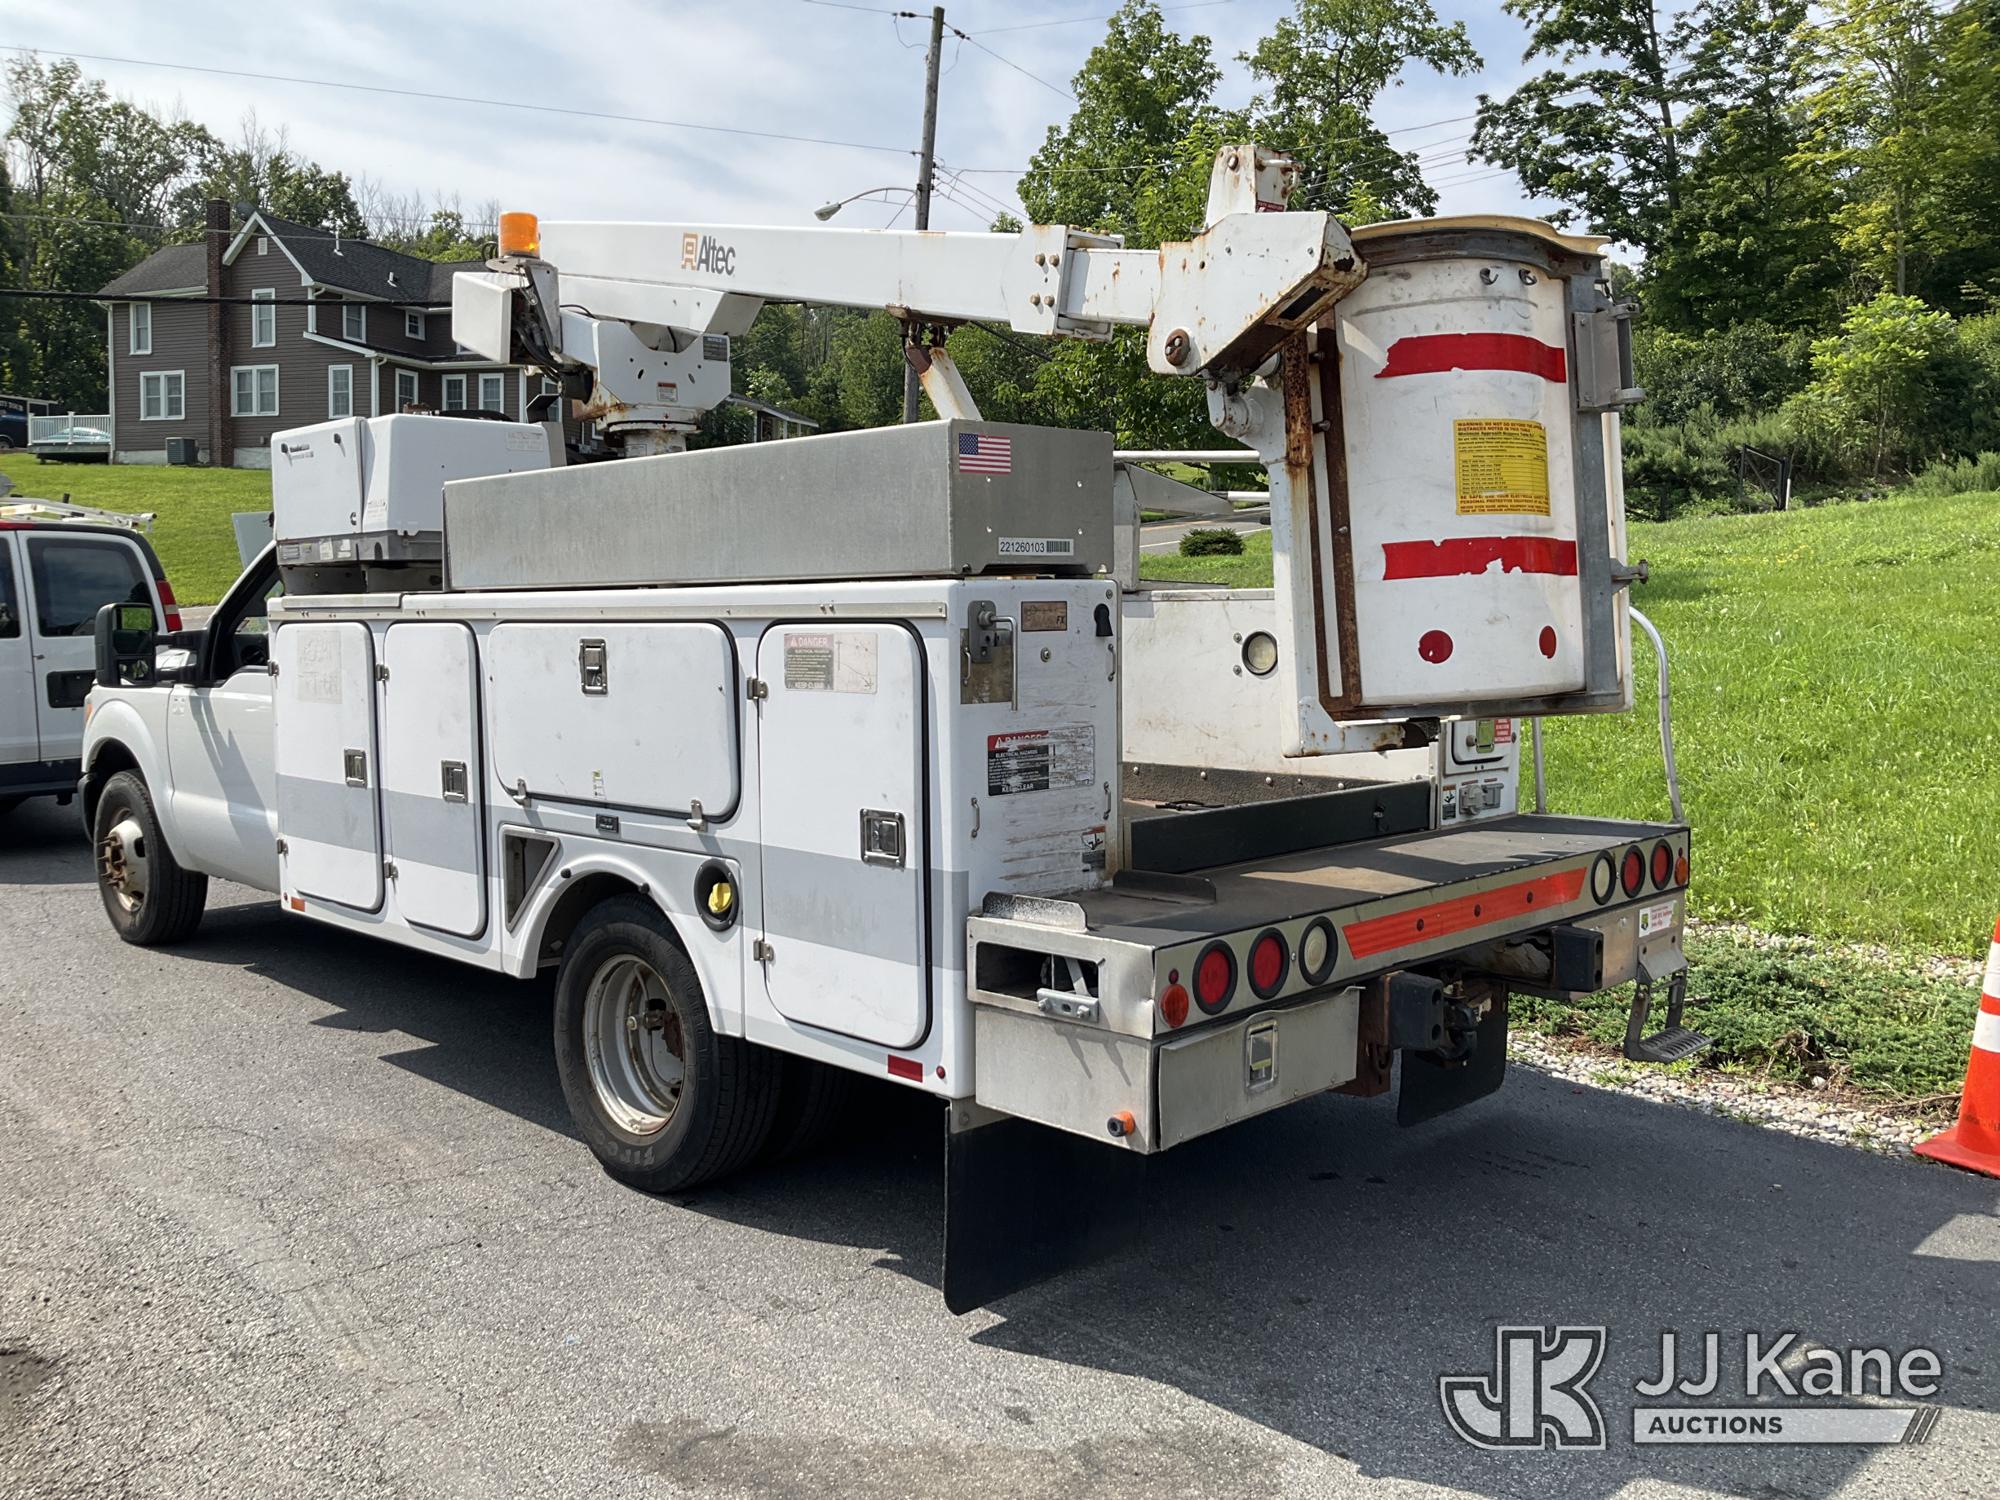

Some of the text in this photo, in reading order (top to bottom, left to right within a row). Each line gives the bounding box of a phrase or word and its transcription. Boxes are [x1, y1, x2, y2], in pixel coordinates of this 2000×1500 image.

[697, 235, 736, 276] Altec
[1000, 541, 1045, 553] 221260103
[799, 637, 828, 648] DANGER
